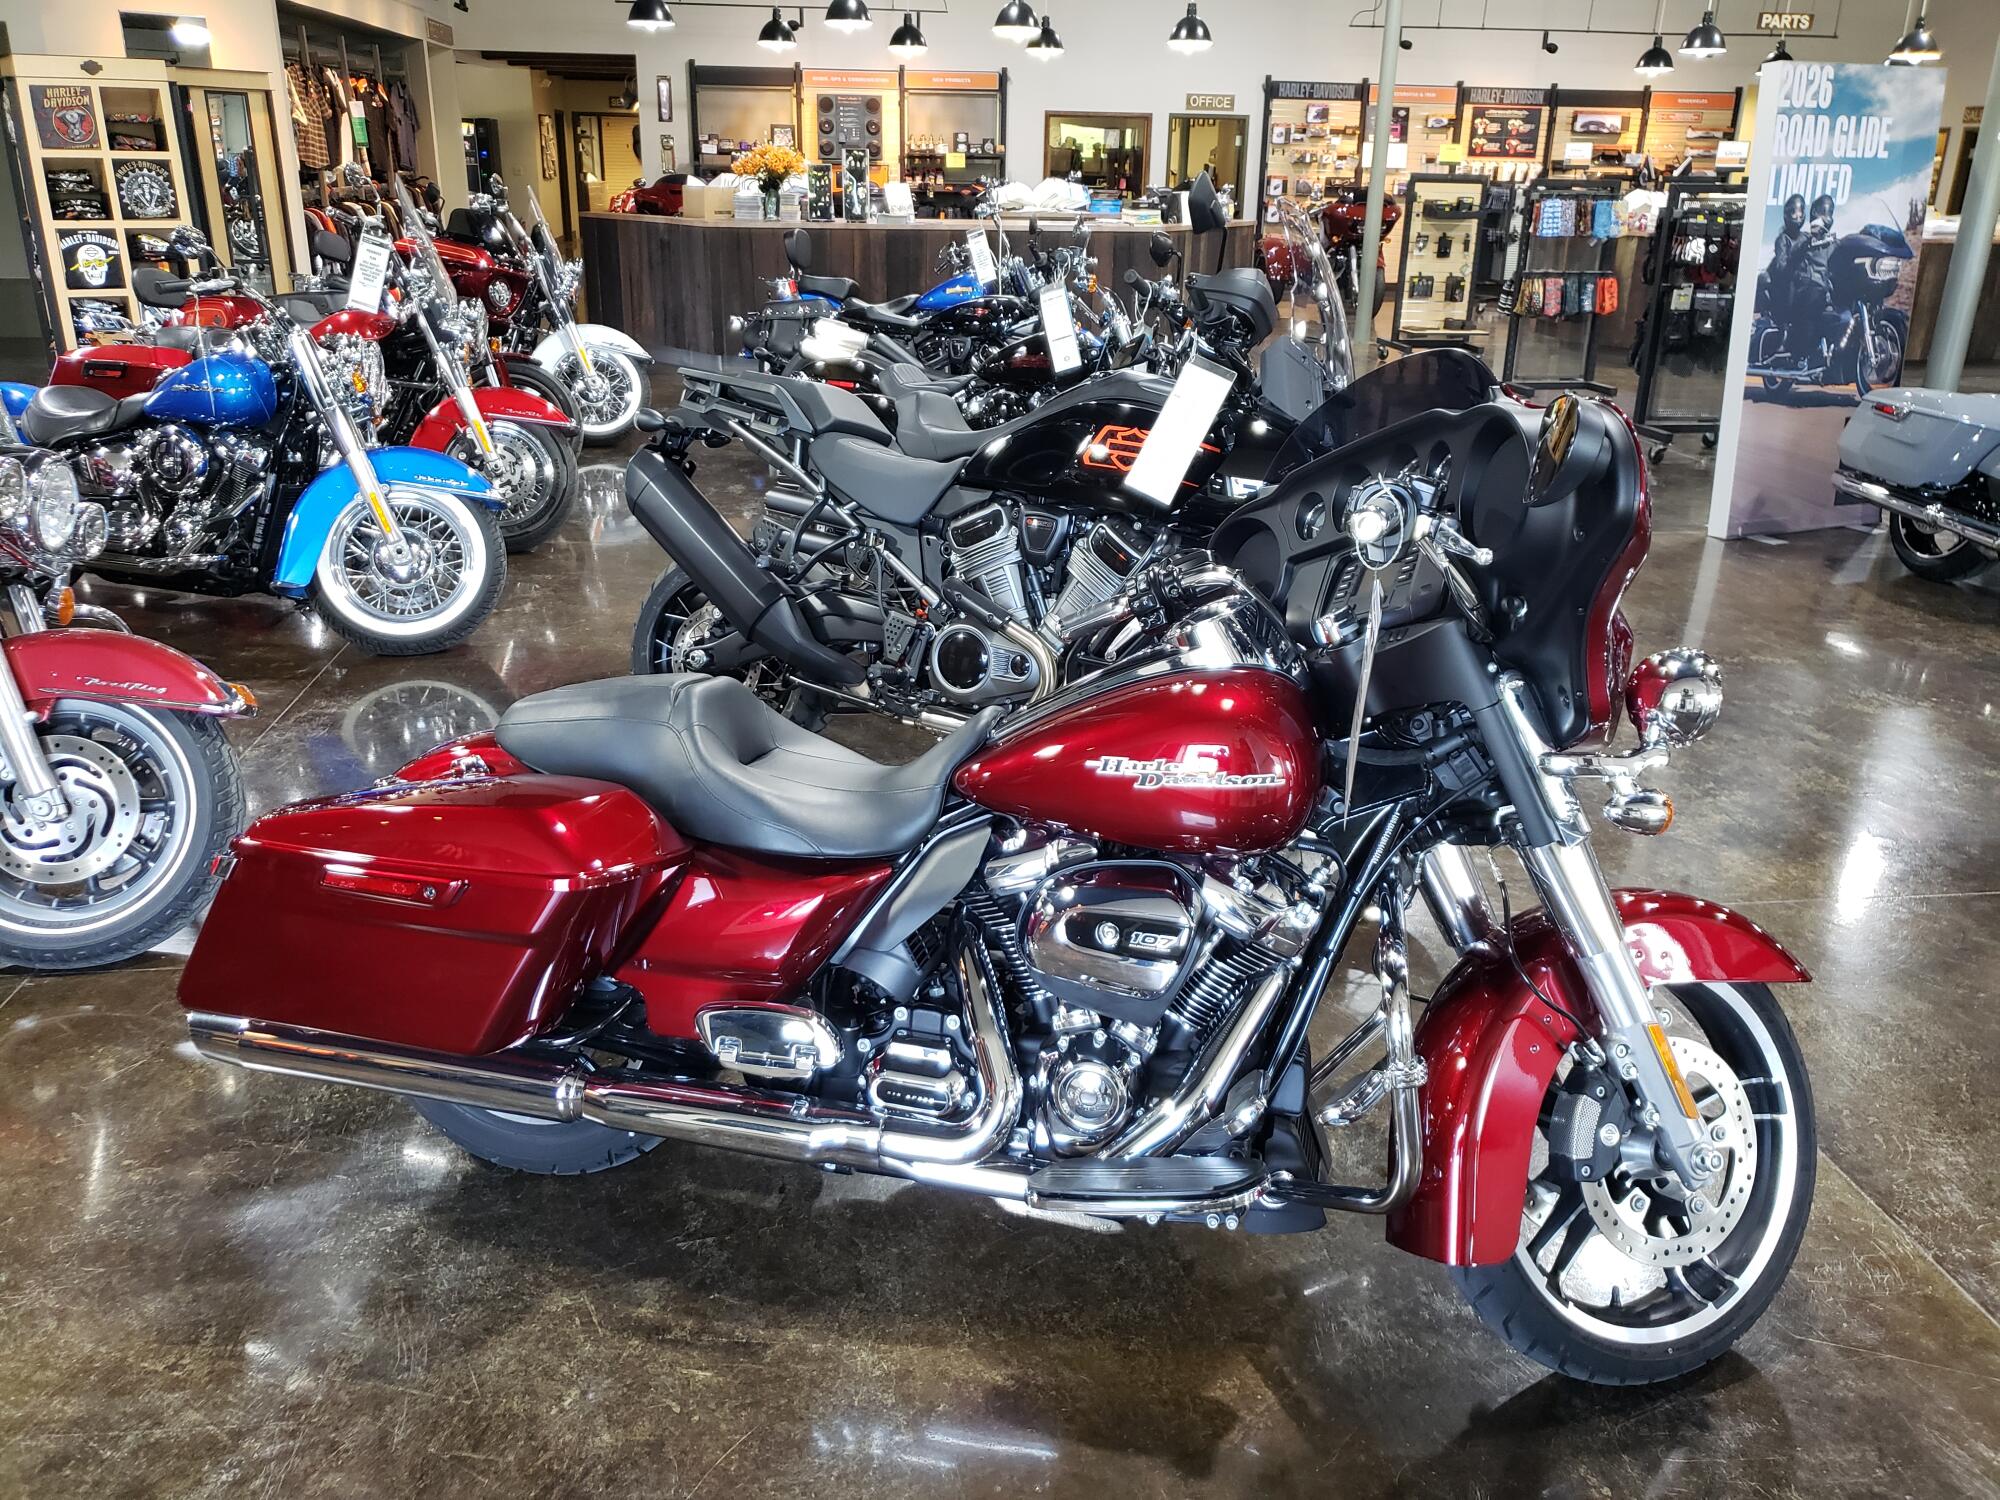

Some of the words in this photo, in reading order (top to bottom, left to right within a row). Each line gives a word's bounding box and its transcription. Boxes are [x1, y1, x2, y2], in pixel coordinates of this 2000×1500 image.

[1761, 14, 1810, 29] PARTS
[47, 87, 85, 98] HARLEY-
[1278, 83, 1356, 99] HARLEY-DAVIDSON
[1778, 65, 1834, 109] 2026
[44, 96, 89, 108] DAVIDSON
[1190, 96, 1231, 108] OFFICE
[1469, 88, 1545, 104] HARLEY-DAVIDSON
[1772, 114, 1830, 158] ROAD
[1832, 115, 1893, 159] GLIDE
[115, 160, 169, 179] HARLEY-DAVIDSON
[1766, 163, 1853, 206] LIMITED
[1100, 757, 1192, 775] Harle
[1130, 932, 1178, 948] 107
